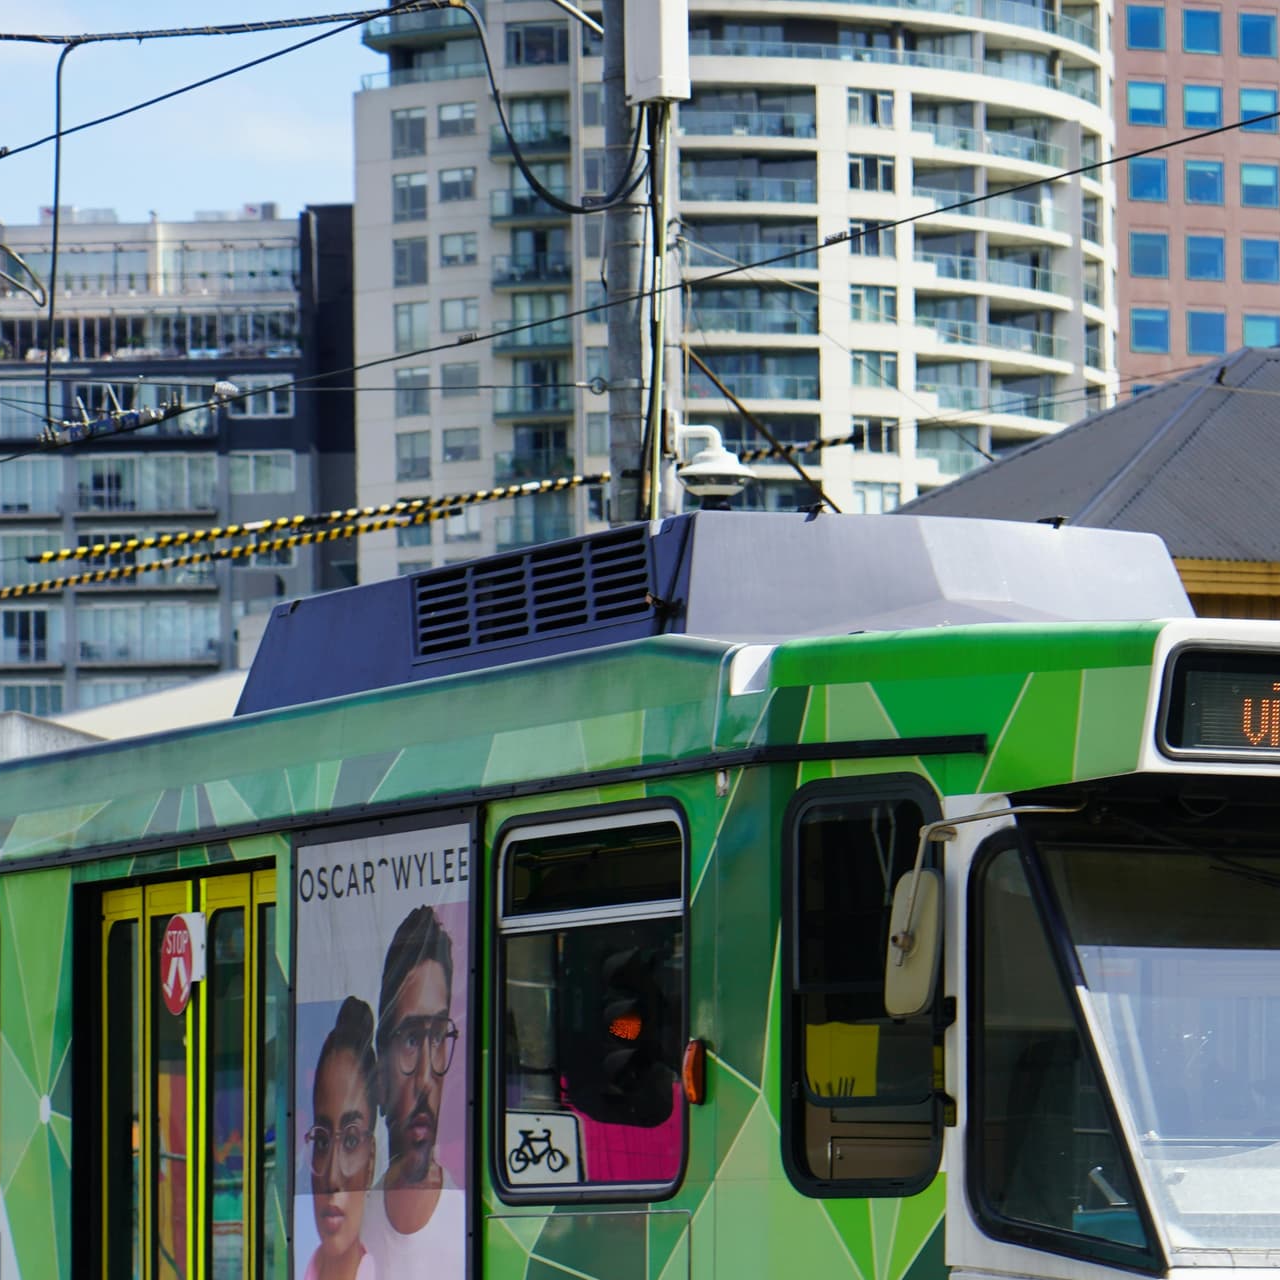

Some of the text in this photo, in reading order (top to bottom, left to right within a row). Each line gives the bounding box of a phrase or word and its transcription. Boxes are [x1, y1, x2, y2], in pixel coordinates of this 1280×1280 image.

[299, 846, 469, 903] OSCAR WYLEE
[166, 930, 189, 954] STOP
